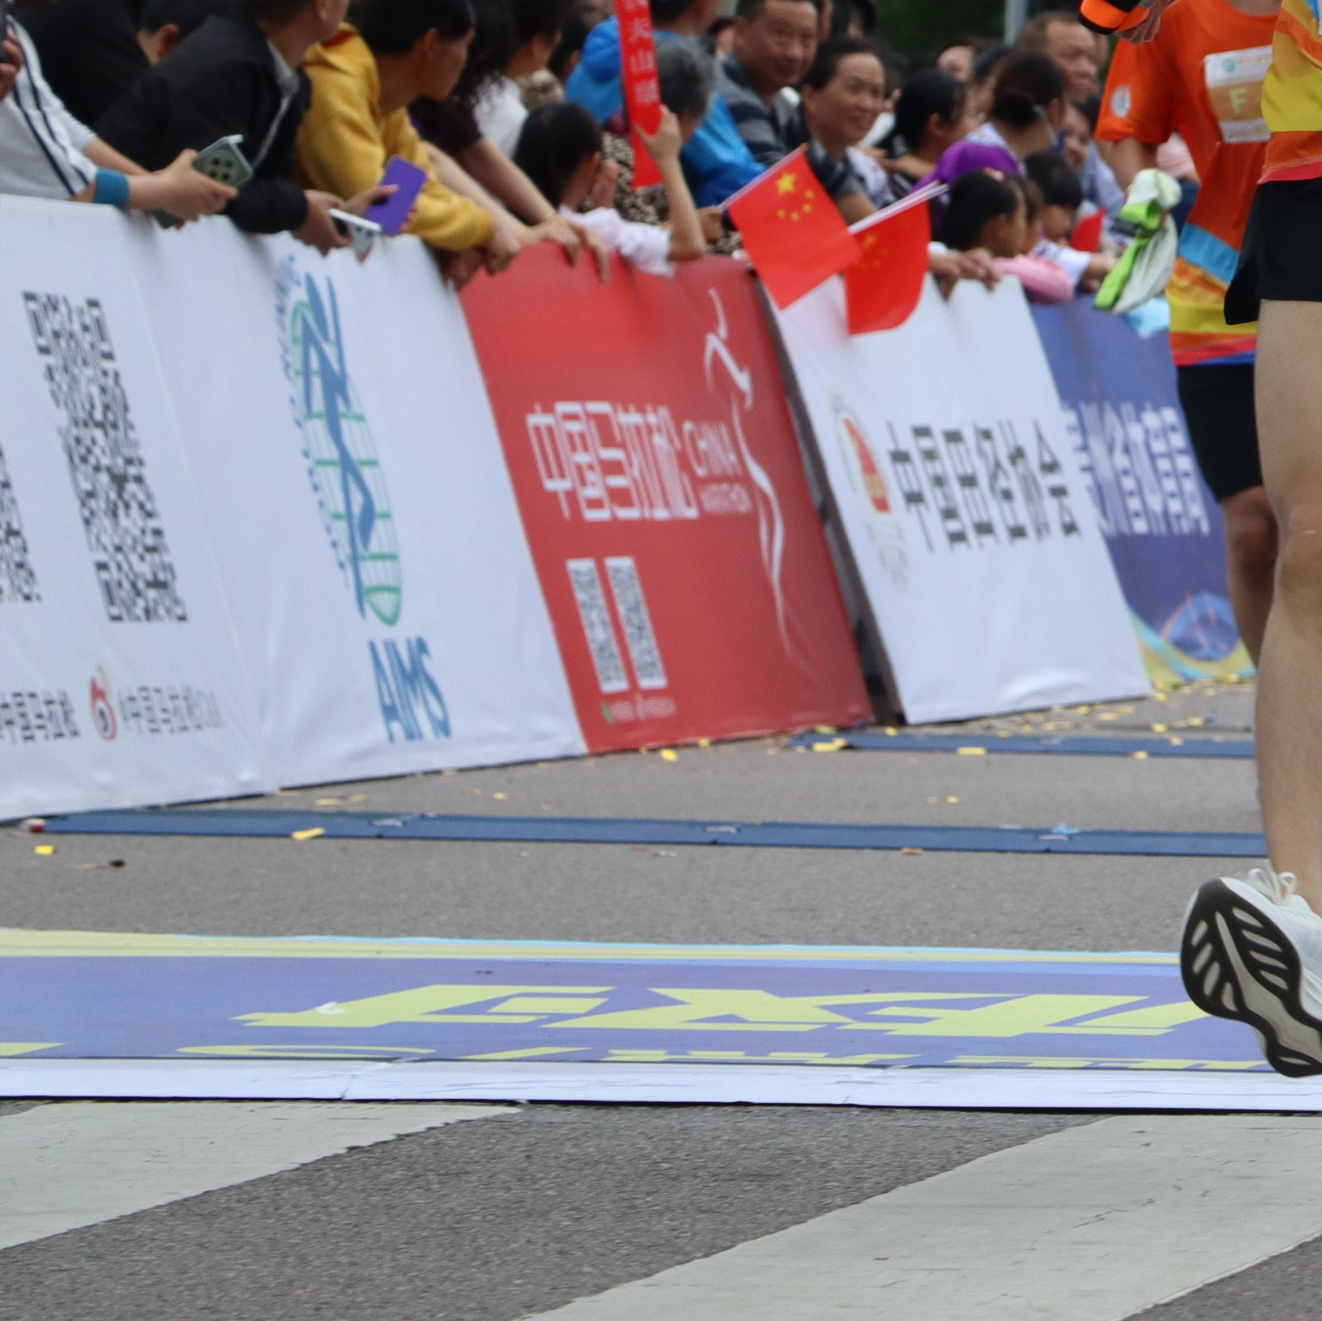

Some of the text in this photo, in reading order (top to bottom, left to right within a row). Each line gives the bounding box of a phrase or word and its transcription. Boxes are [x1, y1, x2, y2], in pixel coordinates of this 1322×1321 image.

[1229, 87, 1248, 114] F
[526, 400, 700, 521] 中国马拉松
[888, 418, 1082, 555] 中国田径协会
[367, 636, 452, 743] AIMS
